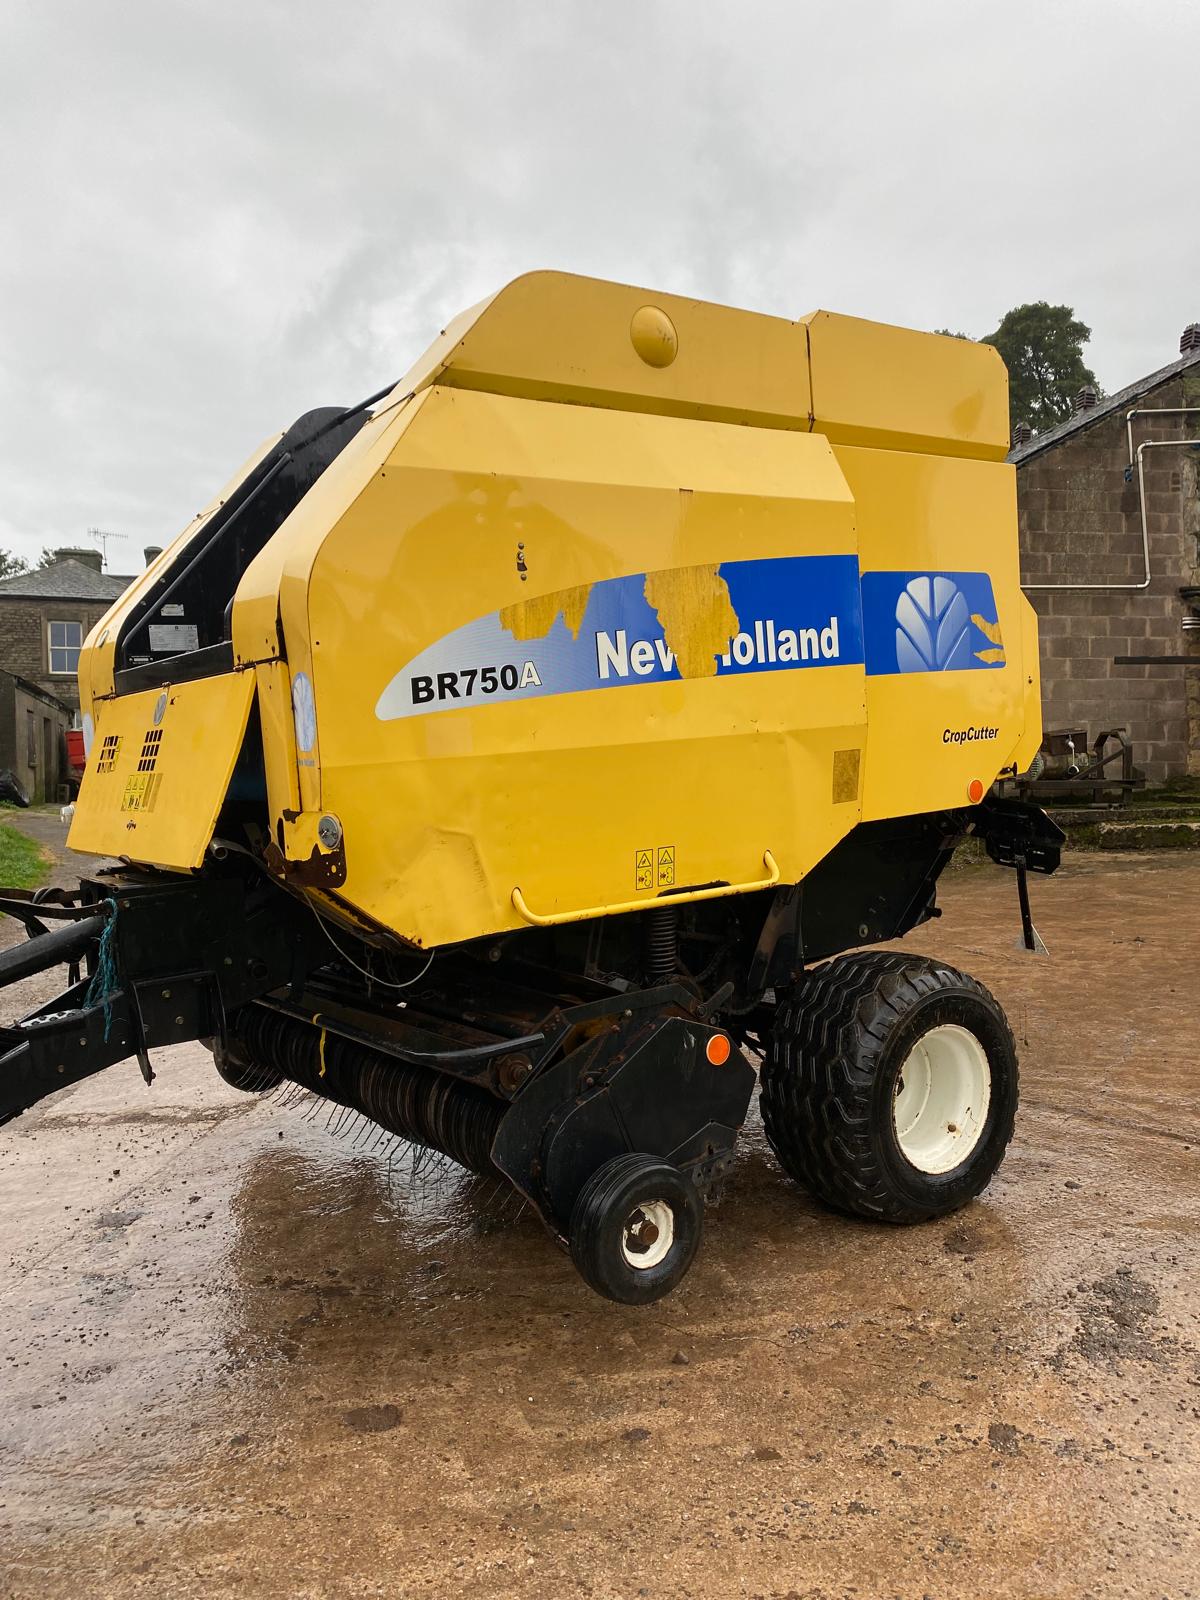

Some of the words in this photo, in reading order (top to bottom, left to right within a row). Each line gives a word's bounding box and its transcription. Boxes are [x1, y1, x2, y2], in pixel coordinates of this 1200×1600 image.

[714, 616, 840, 667] olland
[410, 660, 543, 705] BR750A
[942, 725, 1000, 746] CropCutter
